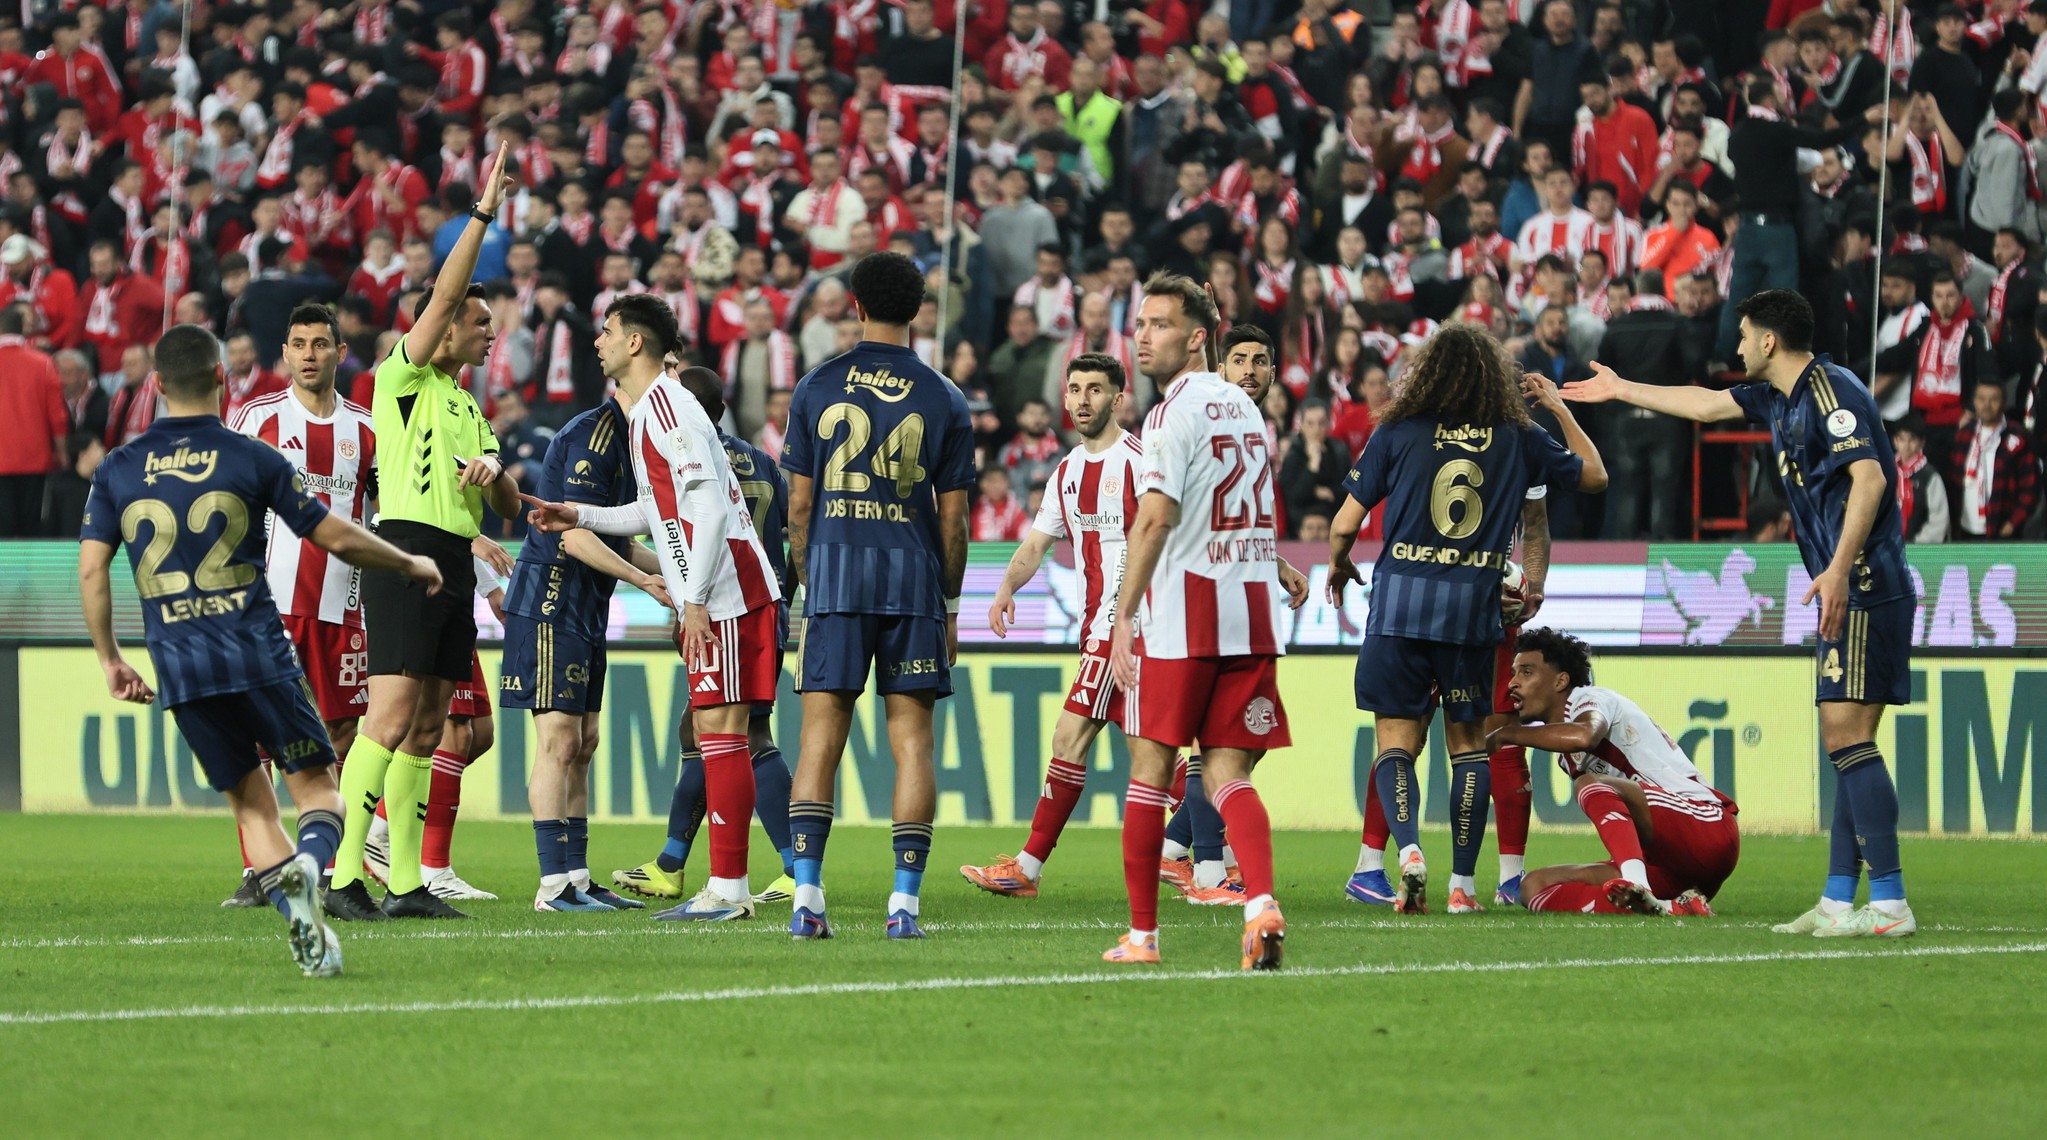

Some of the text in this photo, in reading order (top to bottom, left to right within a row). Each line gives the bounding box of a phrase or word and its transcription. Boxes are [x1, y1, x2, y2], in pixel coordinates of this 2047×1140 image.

[845, 365, 914, 402] halley
[1205, 402, 1248, 421] anex
[818, 402, 926, 499] 24
[1434, 423, 1492, 453] halley
[144, 448, 217, 483] halley
[297, 466, 356, 491] Swandor
[1211, 432, 1274, 531] 22
[1430, 459, 1485, 540] 6
[121, 491, 256, 599] 22
[161, 591, 248, 625] LEVENT
[338, 651, 368, 687] 89
